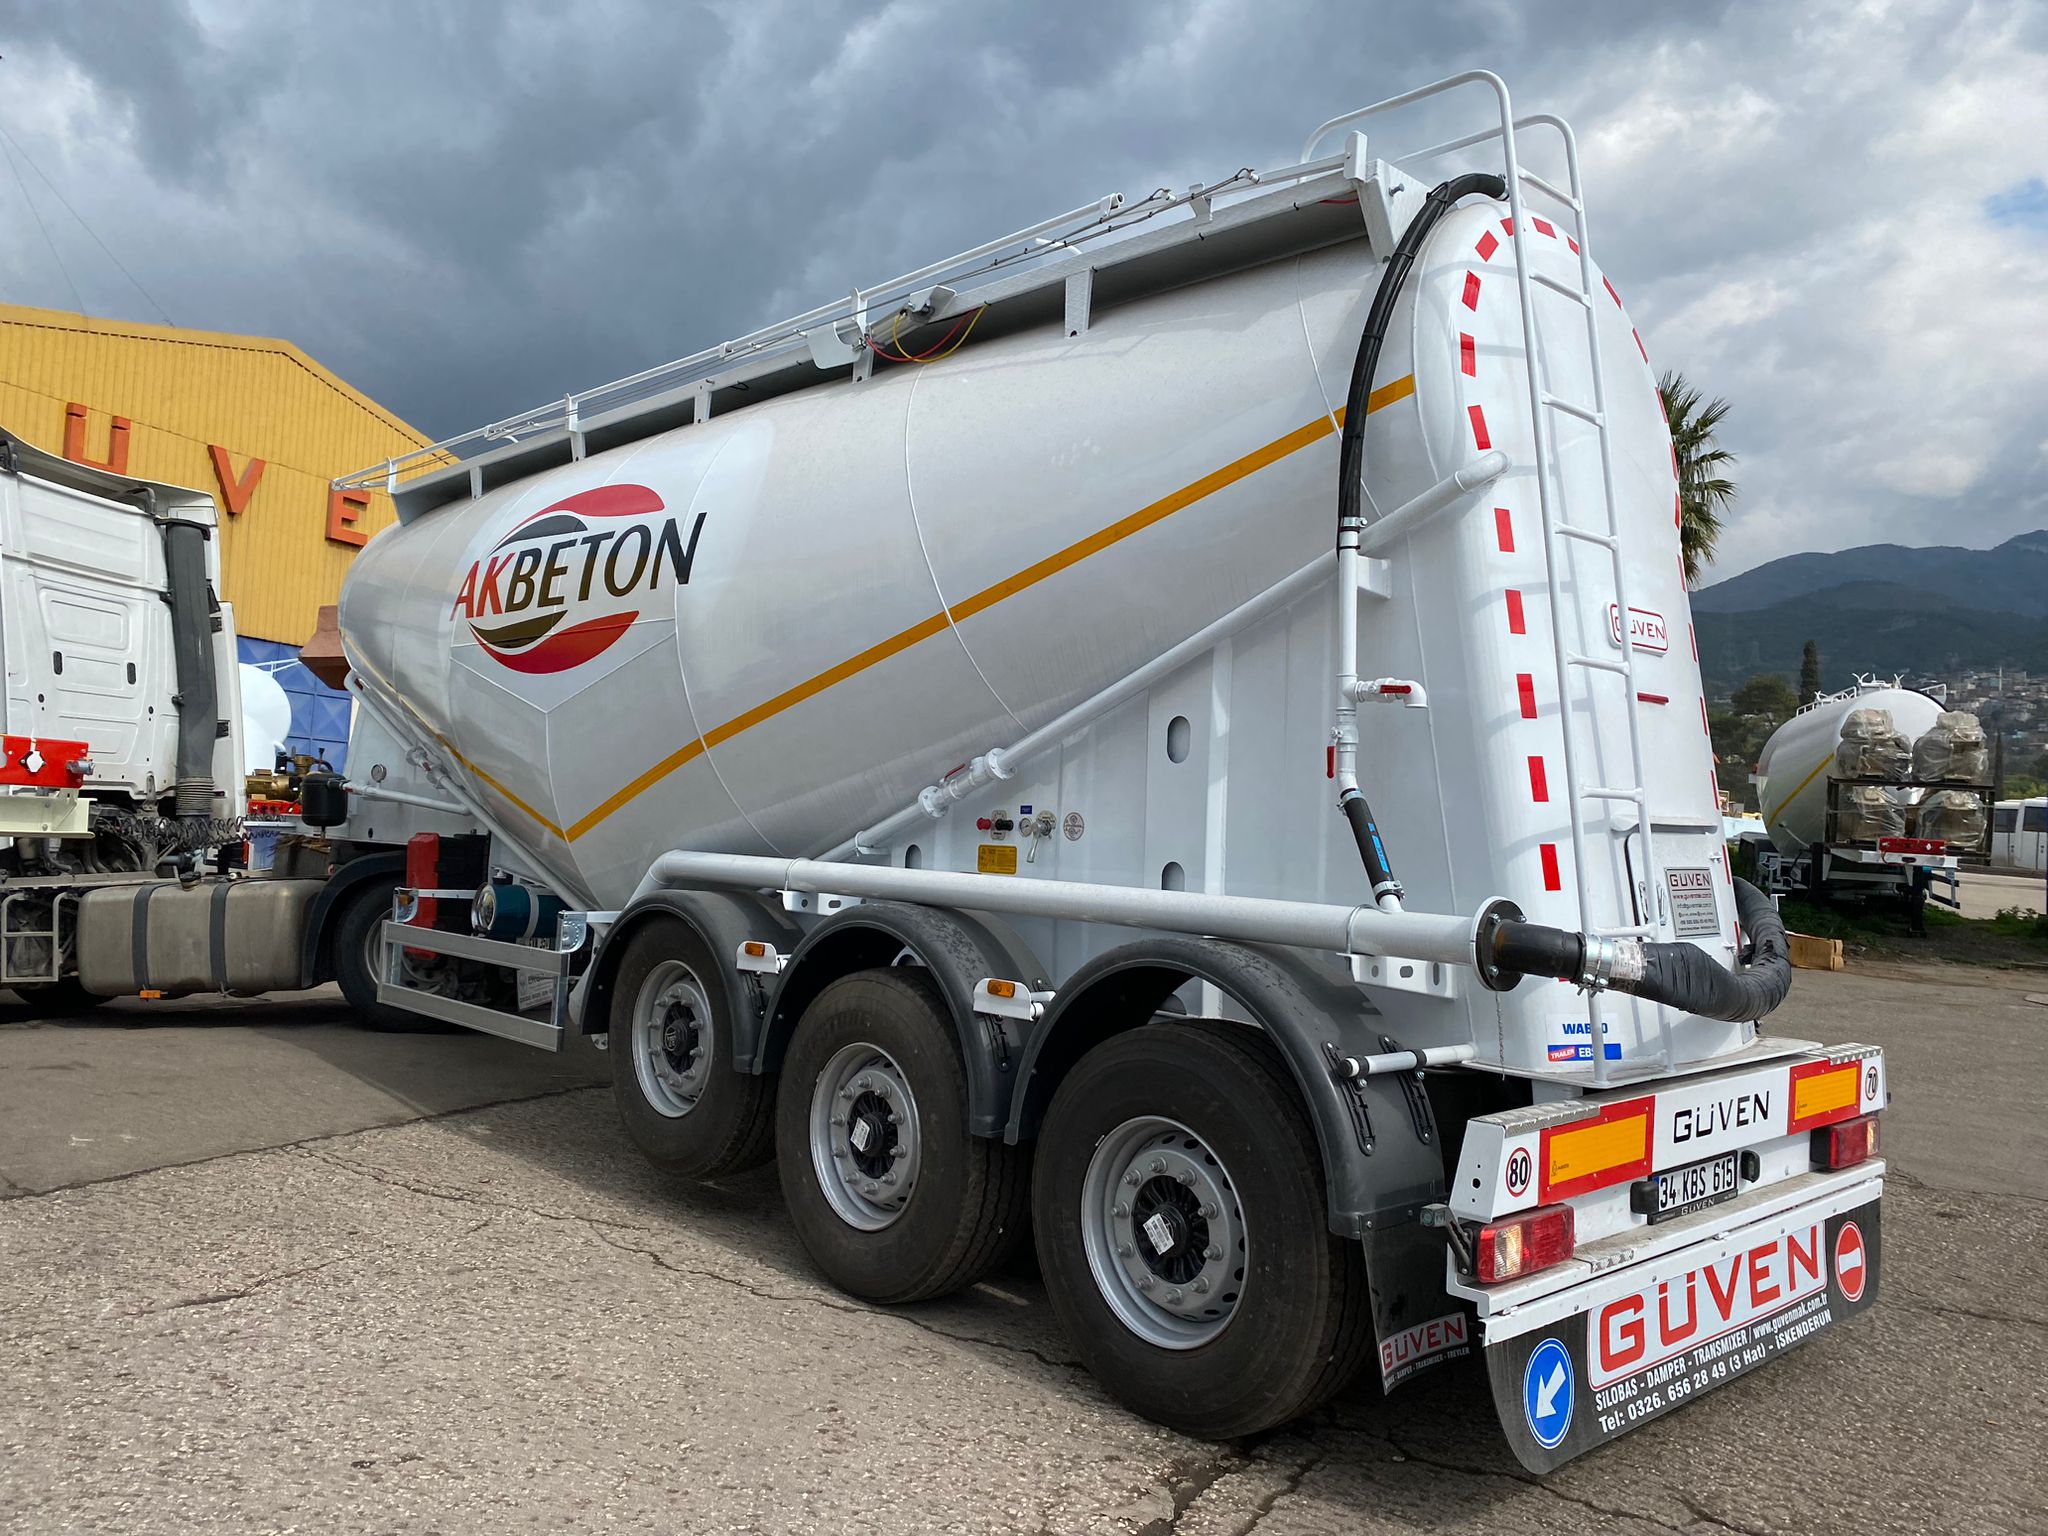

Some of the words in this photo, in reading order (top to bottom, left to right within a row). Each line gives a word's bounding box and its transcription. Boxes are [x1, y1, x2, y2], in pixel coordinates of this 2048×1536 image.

[450, 512, 707, 621] AKBETON
[1669, 873, 1711, 887] GÜVEN
[1550, 1048, 1575, 1060] TRAILER
[1562, 1023, 1608, 1034] WABO
[1868, 1073, 1877, 1094] 70
[1673, 1090, 1769, 1143] GÜVEN
[1510, 1156, 1528, 1187] 80
[1660, 1175, 1676, 1208] 34
[1683, 1166, 1706, 1202] KBS
[1713, 1158, 1733, 1192] 615
[1600, 1225, 1819, 1373] GÜVEN
[1382, 1317, 1464, 1370] GÜVEN
[1647, 1357, 1686, 1389] DAMPER
[1693, 1329, 1748, 1366] TRANSMIXER
[1753, 1292, 1828, 1340] www.guvenmak.com.tr
[1599, 1410, 1625, 1433] Tel:
[1627, 1392, 1666, 1421] 0326.
[1668, 1378, 1691, 1401] 656
[1693, 1369, 1708, 1390] 28
[1711, 1361, 1727, 1379] 49
[1729, 1354, 1742, 1372] (3
[1743, 1343, 1766, 1365] Hat)
